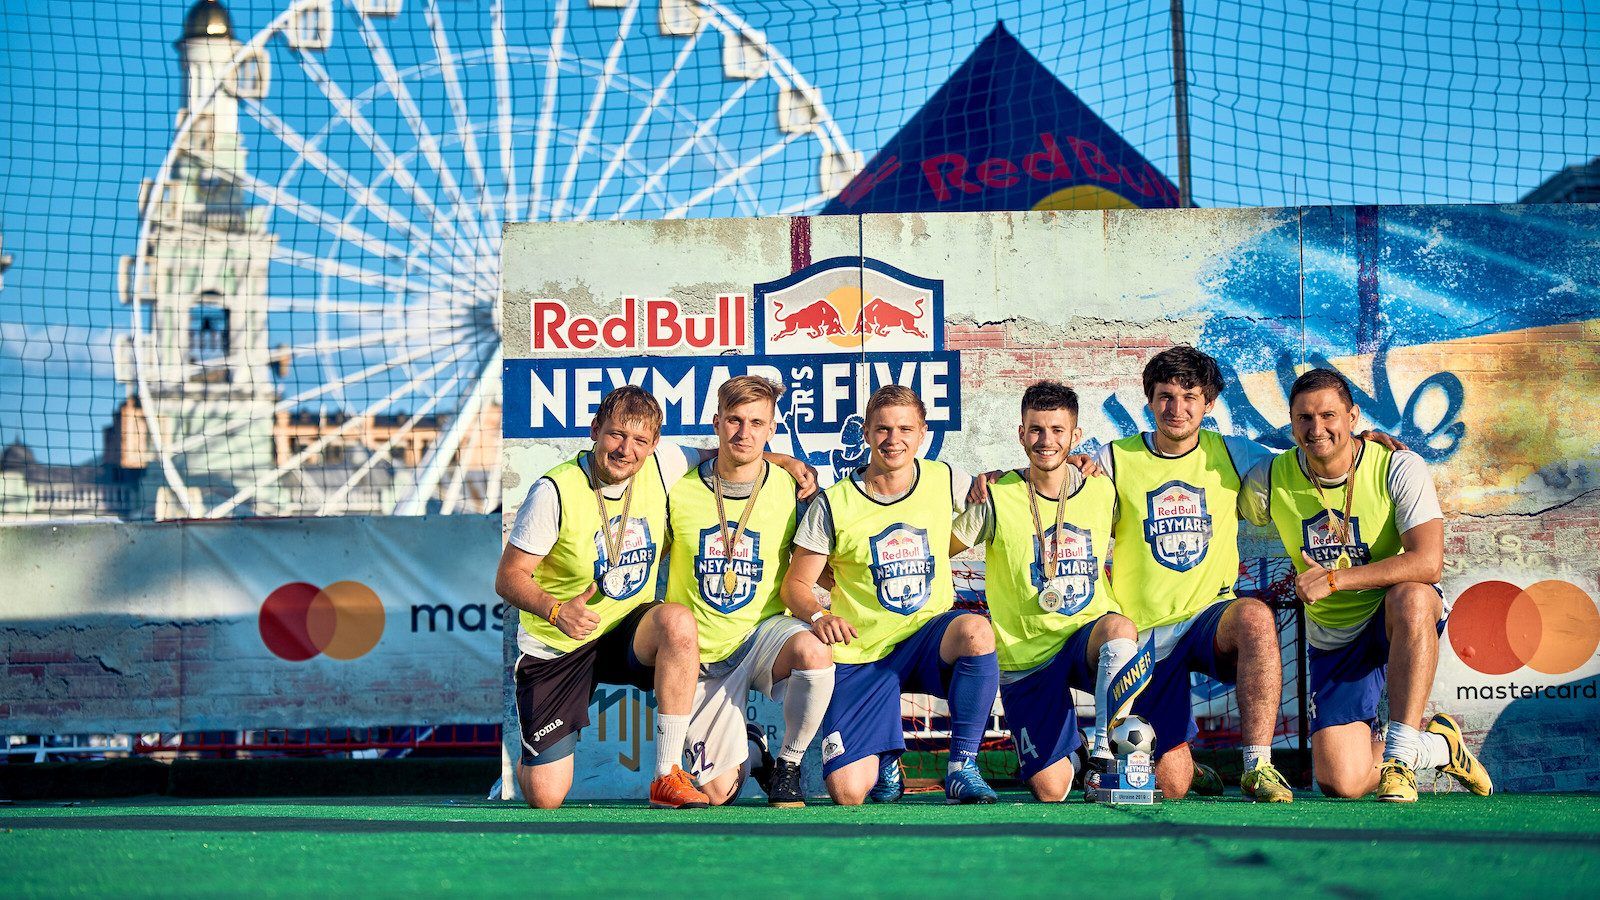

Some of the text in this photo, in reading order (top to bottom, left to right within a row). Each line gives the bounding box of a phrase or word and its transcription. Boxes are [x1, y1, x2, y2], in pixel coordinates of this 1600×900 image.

[920, 131, 1073, 202] Red
[533, 296, 745, 349] Red Bull
[1158, 505, 1197, 516] Red Bull
[1149, 518, 1202, 537] NEYMAR
[1333, 533, 1351, 544] Bl
[600, 550, 648, 575] NMAR
[882, 547, 920, 561] Red Bull
[1045, 547, 1083, 560] Rd Bull
[699, 560, 752, 575] NEYMAR
[877, 561, 926, 579] NEYMAR
[1113, 651, 1152, 701] WINNER
[1456, 680, 1598, 700] mastercard
